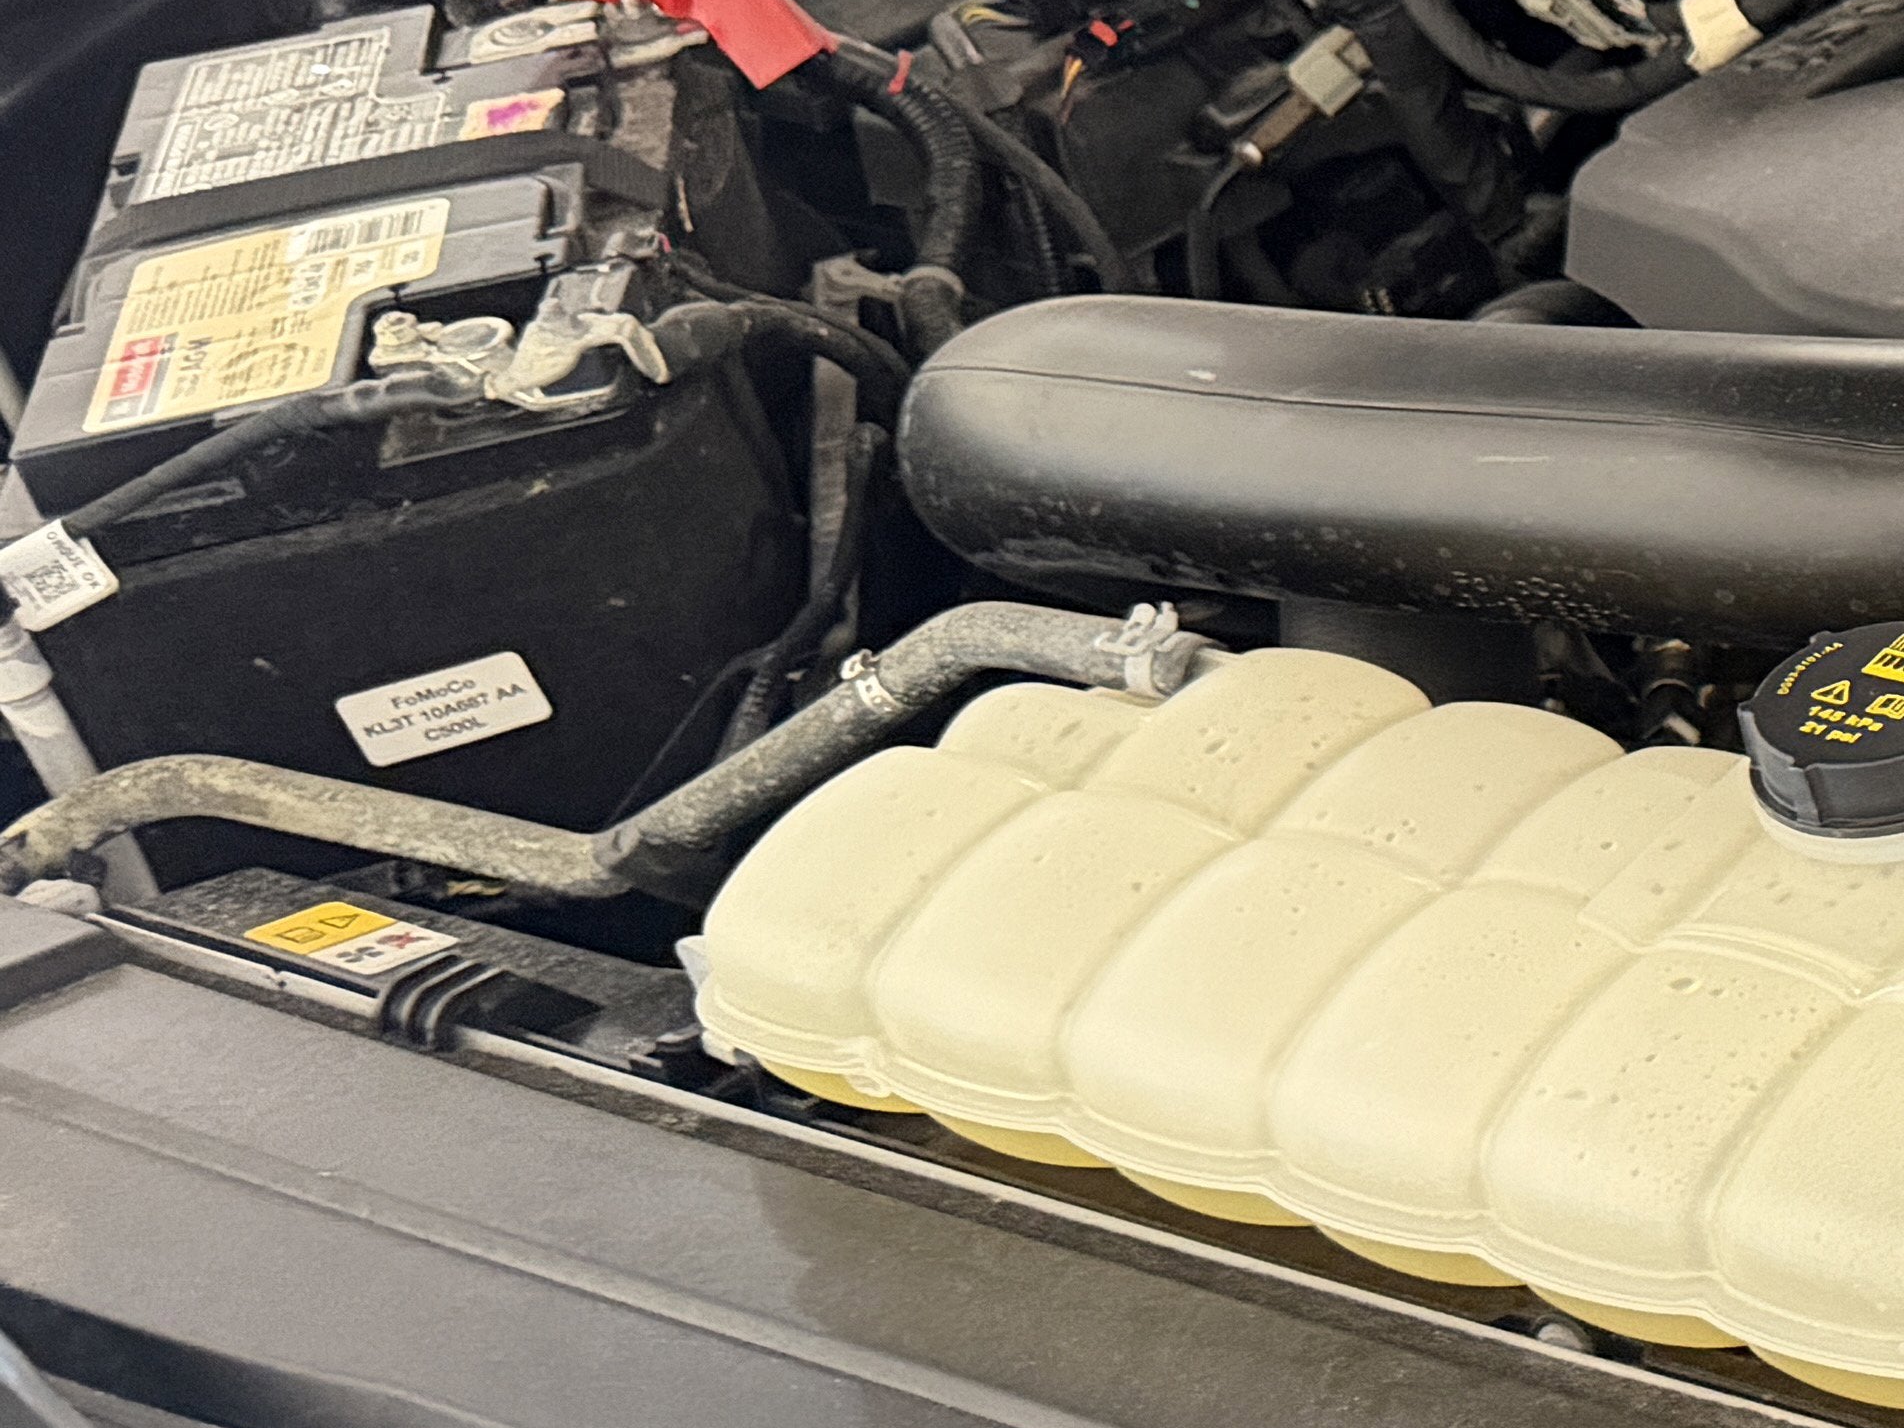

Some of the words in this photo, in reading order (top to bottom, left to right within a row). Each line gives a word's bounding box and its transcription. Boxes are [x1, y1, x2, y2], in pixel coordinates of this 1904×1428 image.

[390, 678, 478, 710] FoMoCo
[362, 713, 416, 739] KL3T
[496, 682, 528, 702] AA
[1808, 705, 1846, 723] 145
[1798, 720, 1828, 736] 21
[1825, 729, 1862, 745] psi
